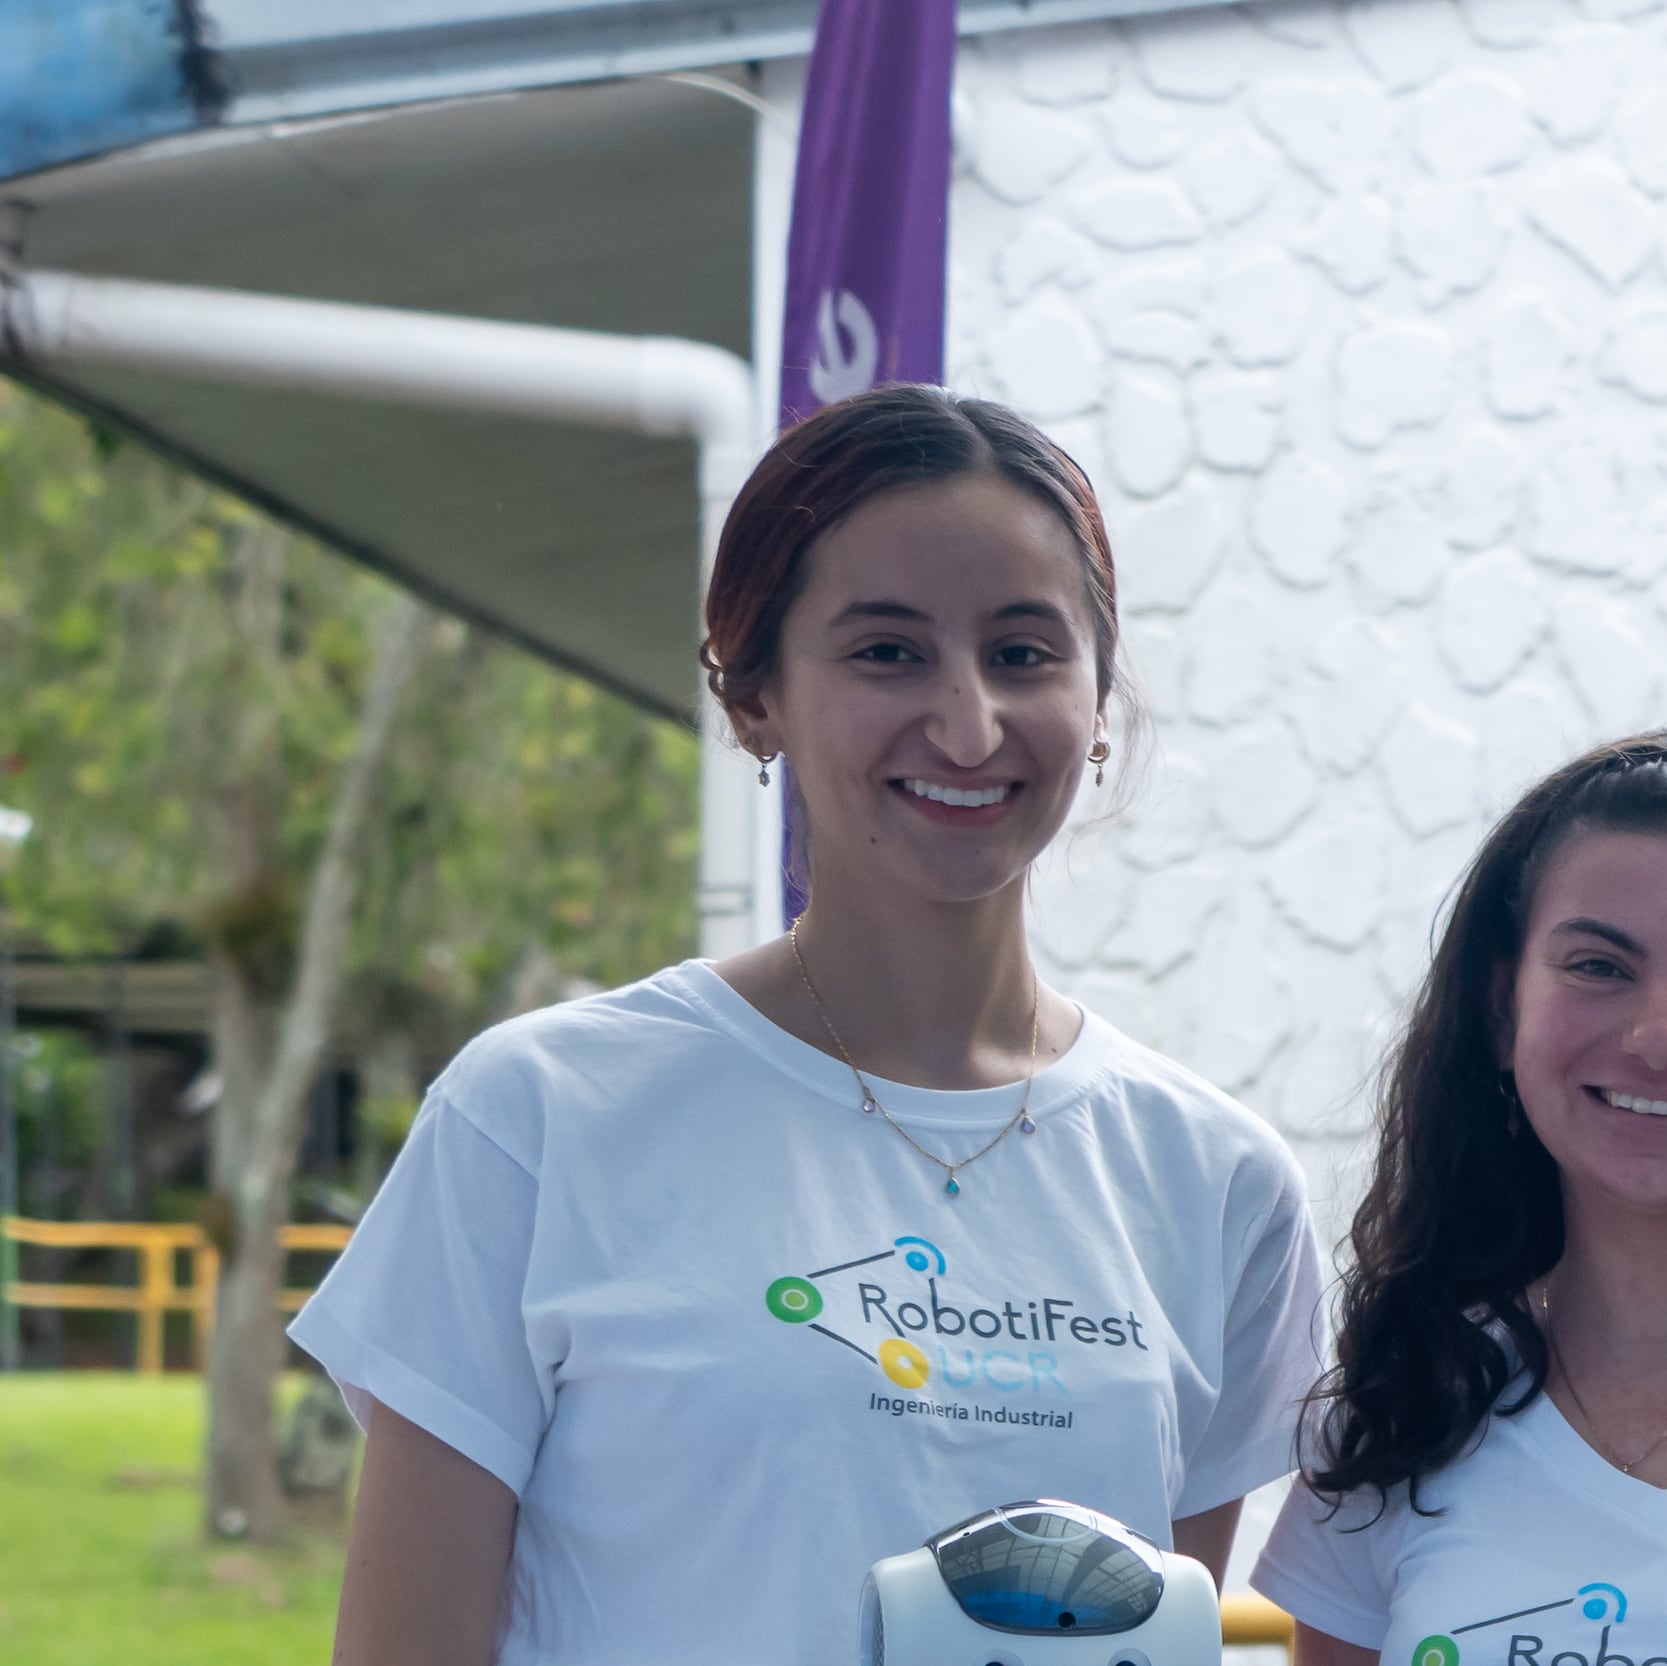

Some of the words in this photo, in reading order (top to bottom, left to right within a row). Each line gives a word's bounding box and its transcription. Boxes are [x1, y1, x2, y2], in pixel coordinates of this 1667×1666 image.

[858, 1277, 1150, 1351] RobotiFest
[938, 1345, 1069, 1396] UCR
[869, 1392, 969, 1422] Ingeniería
[974, 1404, 1074, 1430] Industrial
